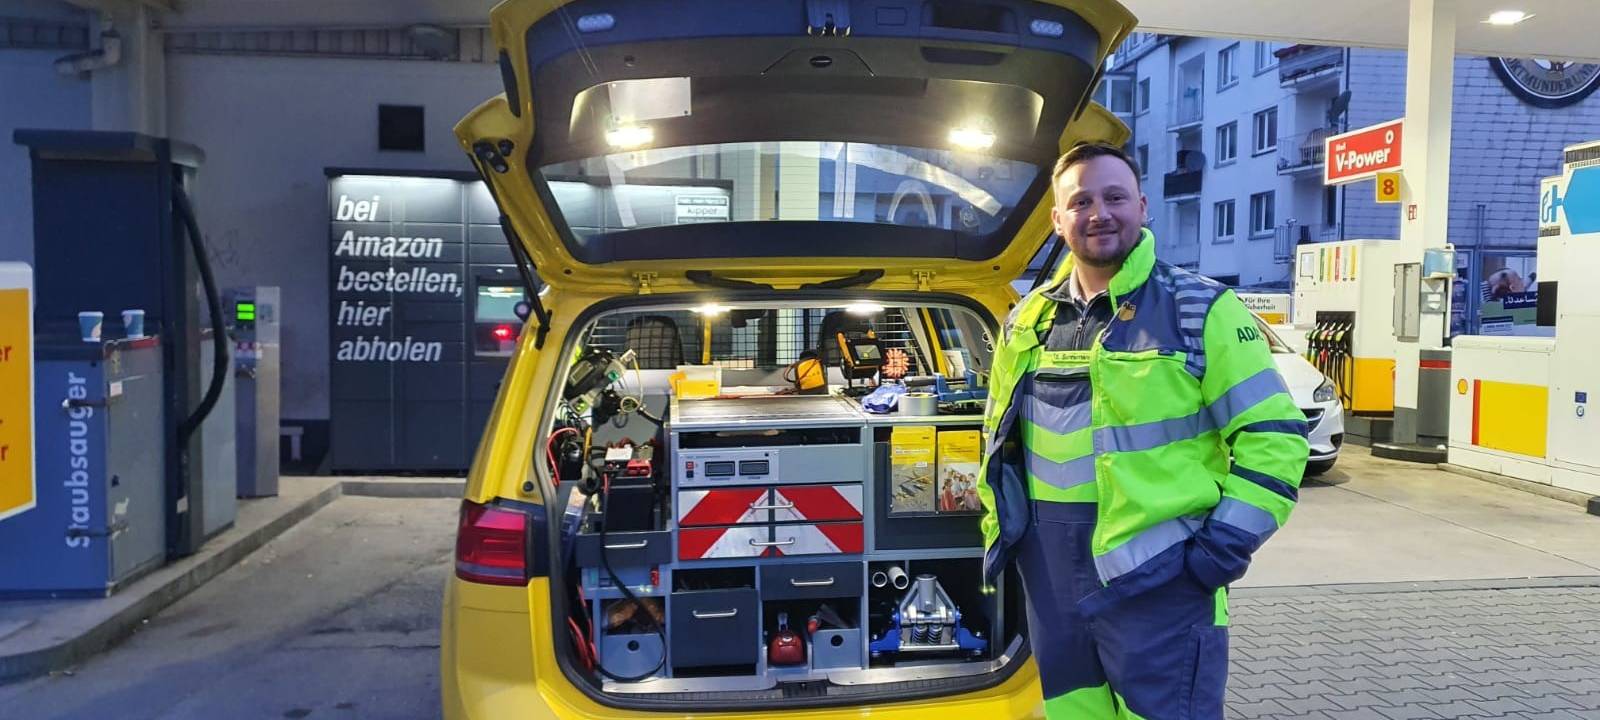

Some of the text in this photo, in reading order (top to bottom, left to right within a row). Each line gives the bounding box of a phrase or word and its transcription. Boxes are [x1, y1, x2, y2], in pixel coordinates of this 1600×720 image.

[1336, 147, 1392, 172] V-Power
[1383, 179, 1395, 196] 8
[336, 195, 380, 221] bei
[335, 230, 443, 258] Amazon
[337, 265, 463, 298] bestellen,
[337, 301, 390, 326] hier
[337, 336, 442, 362] abholen
